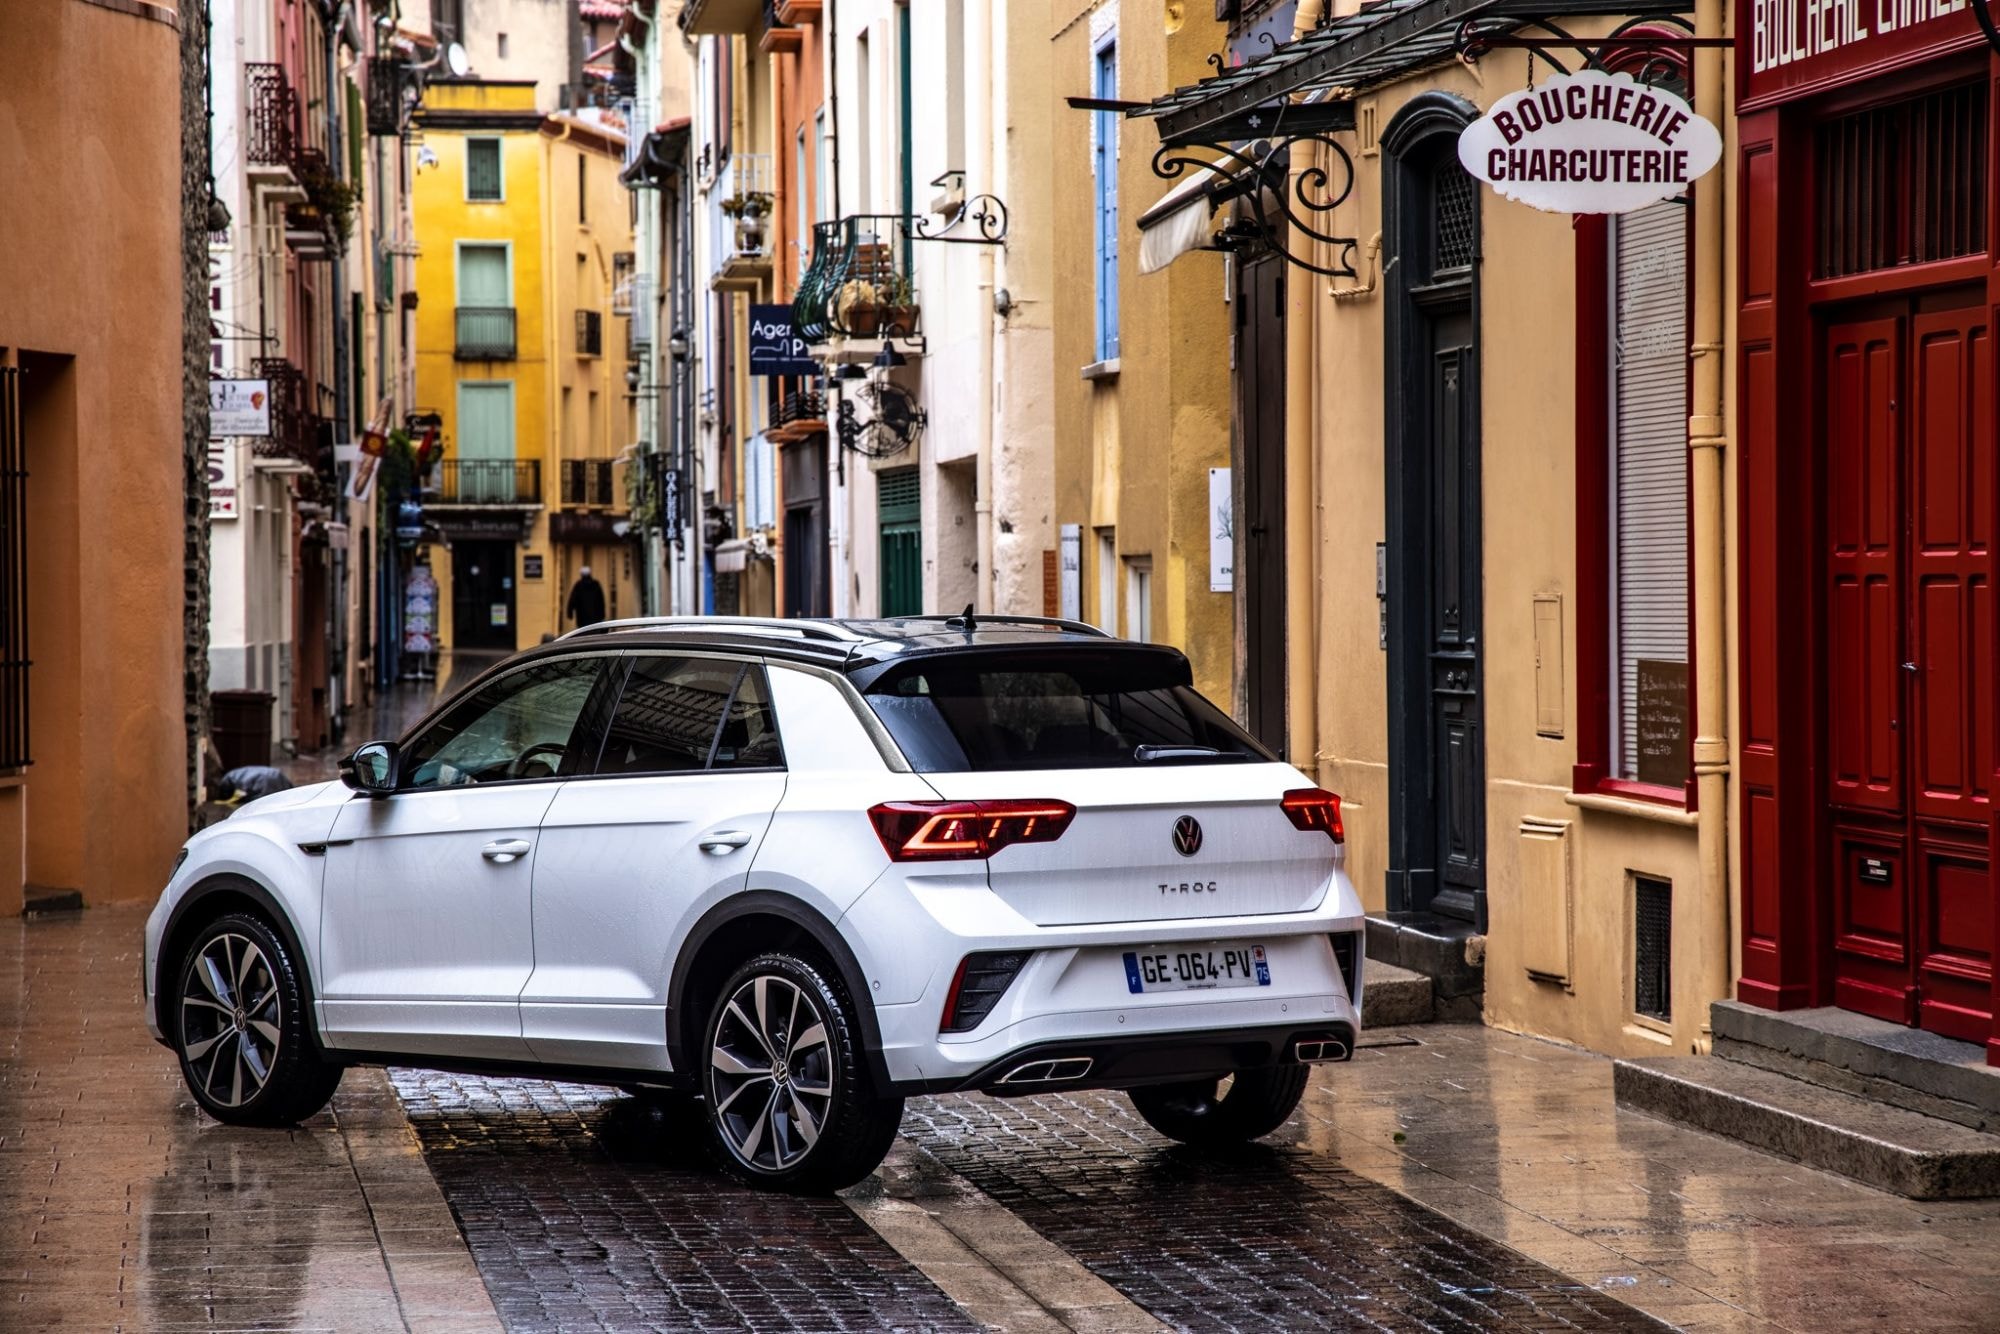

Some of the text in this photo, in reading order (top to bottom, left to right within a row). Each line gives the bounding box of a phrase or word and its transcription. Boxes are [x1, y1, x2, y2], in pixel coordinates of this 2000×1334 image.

[1492, 84, 1690, 147] BOUCHERIE
[1488, 149, 1689, 183] CHARCUTERIE
[1158, 882, 1217, 894] T-ROC
[1257, 967, 1269, 981] 75
